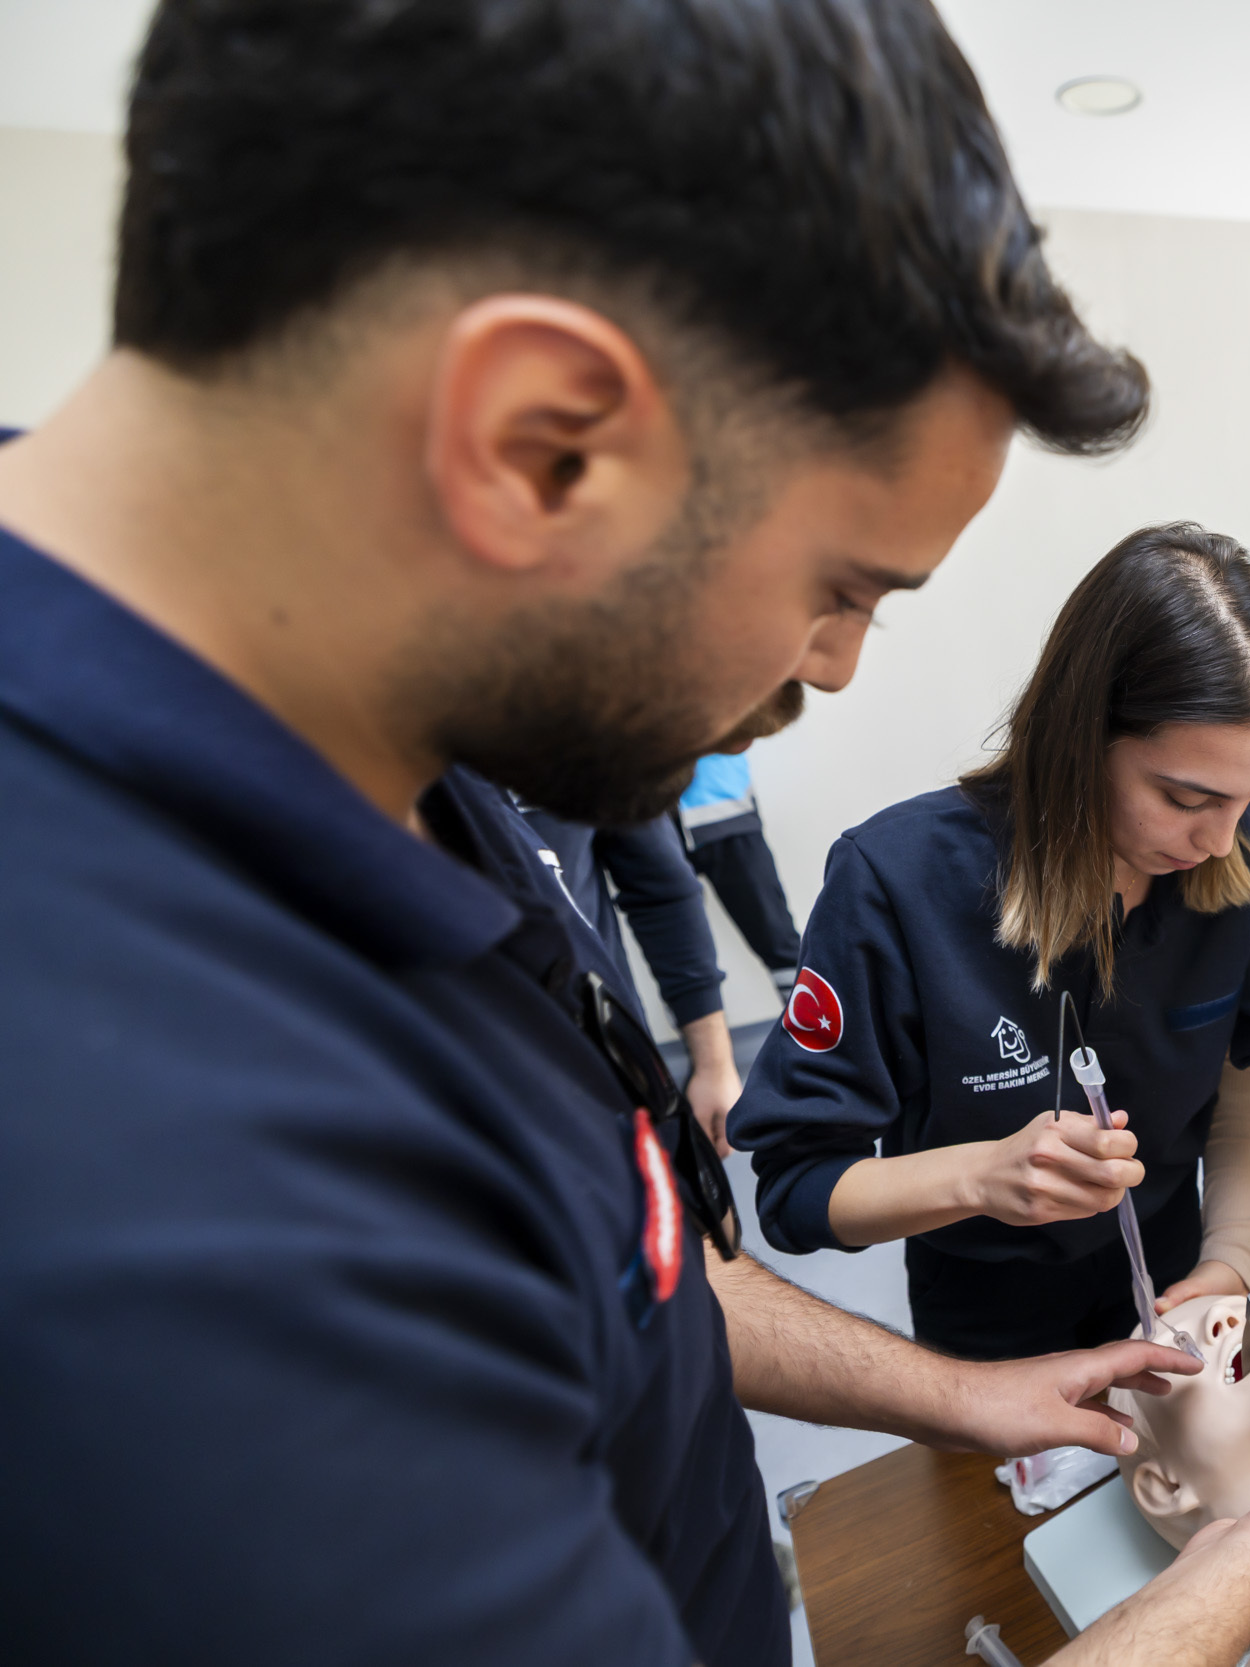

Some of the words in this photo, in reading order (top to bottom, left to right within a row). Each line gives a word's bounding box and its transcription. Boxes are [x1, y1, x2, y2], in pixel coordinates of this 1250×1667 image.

[961, 1075, 985, 1085] ÖZEL
[986, 1068, 1019, 1082] MERSİN
[973, 1083, 997, 1092] EVDE
[998, 1077, 1026, 1090] BAKIM
